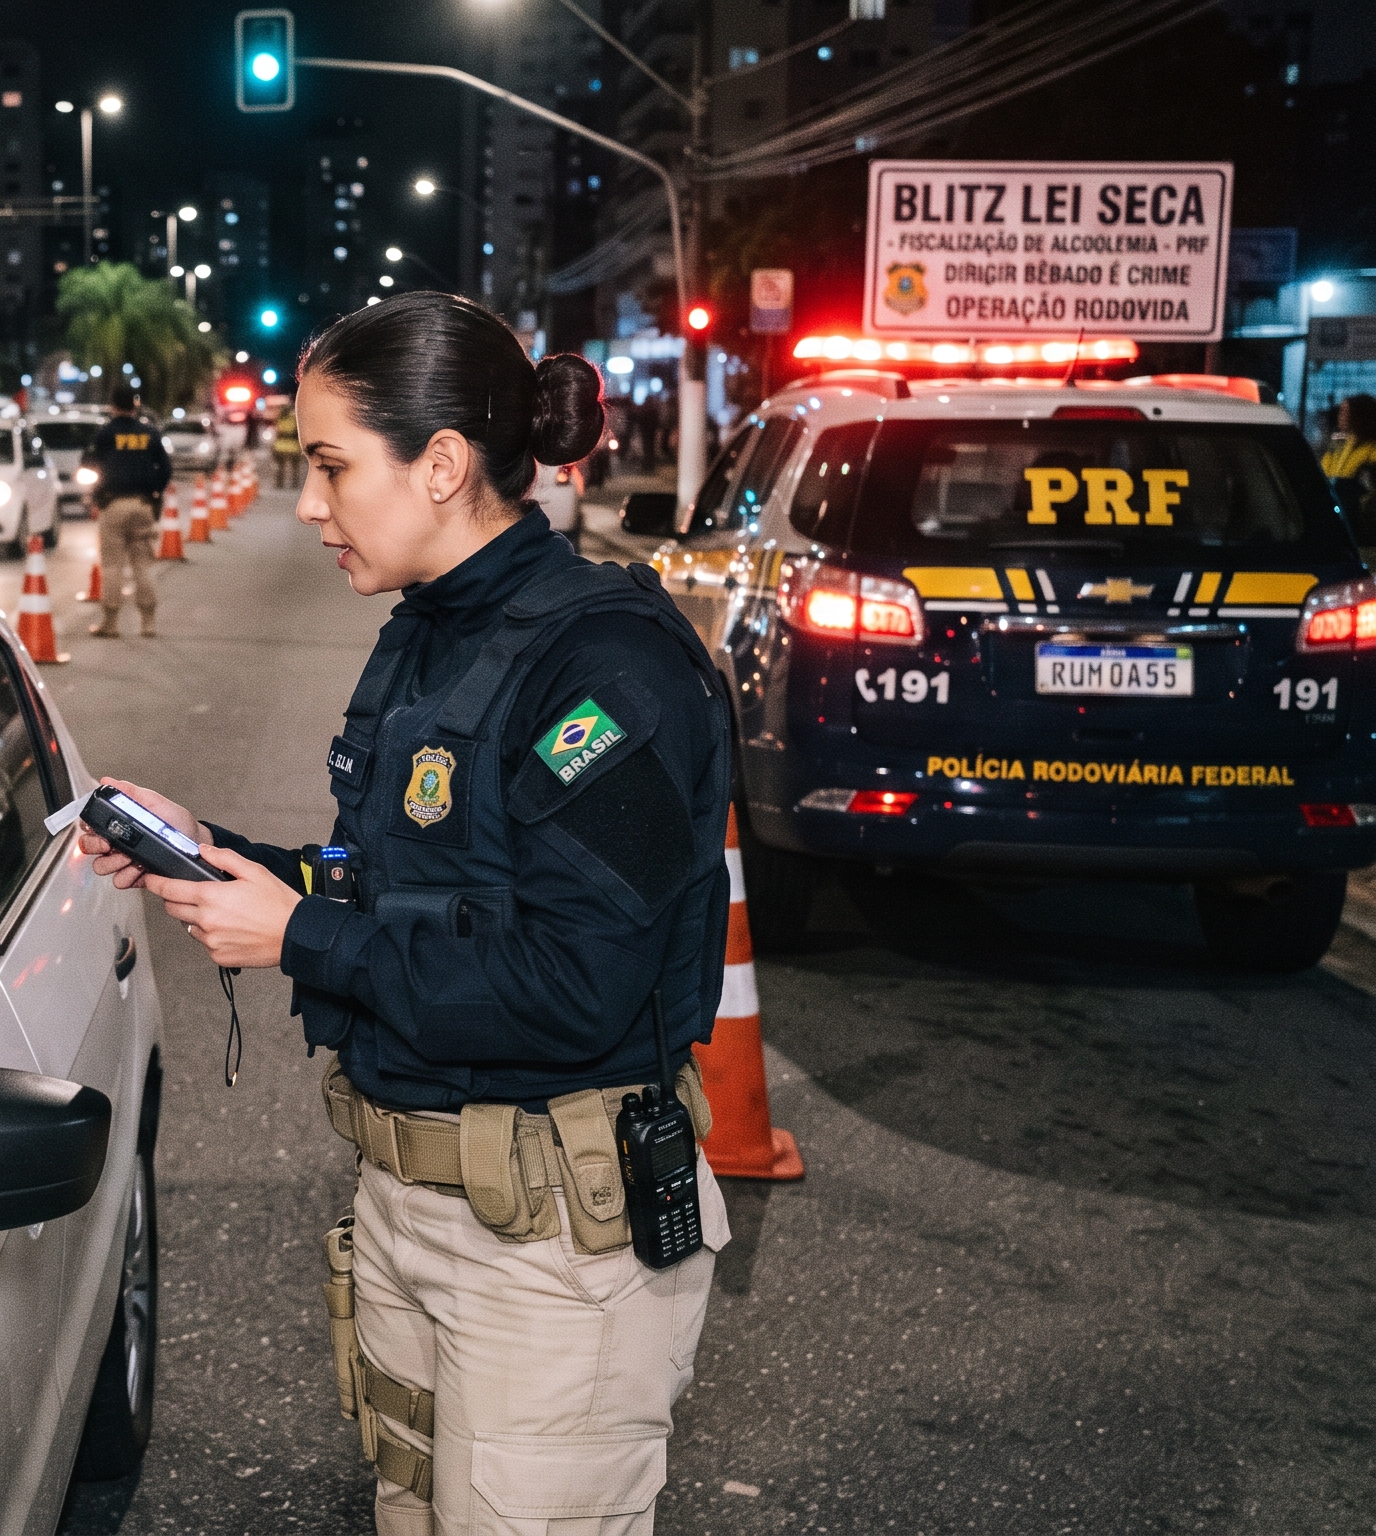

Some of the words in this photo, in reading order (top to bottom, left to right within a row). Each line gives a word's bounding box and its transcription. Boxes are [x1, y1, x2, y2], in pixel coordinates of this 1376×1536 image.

[894, 184, 1006, 223] BLITZ
[1022, 184, 1081, 224] LEI
[1098, 184, 1205, 225] SECA
[899, 230, 1018, 257] FISCALIZAÇÃO
[1024, 233, 1045, 253] DE
[1051, 234, 1158, 254] ALCOOLEMIA
[1176, 235, 1209, 254] PRF
[945, 262, 1017, 286] DIRIGIR
[1024, 259, 1102, 285] BÊBADO
[1109, 260, 1122, 286] É
[1128, 264, 1191, 286] CRIME
[946, 291, 1066, 325] OPERAÇÃO
[1075, 298, 1189, 322] RODOVIDA
[1024, 467, 1189, 526] PRF
[877, 667, 950, 704] 191
[1273, 677, 1338, 711] 191
[558, 730, 622, 782] BRASIL
[926, 753, 1025, 780] POLÍCIA
[1033, 759, 1185, 785] RODOVIÁRIA
[1191, 765, 1295, 787] FEDERAL
